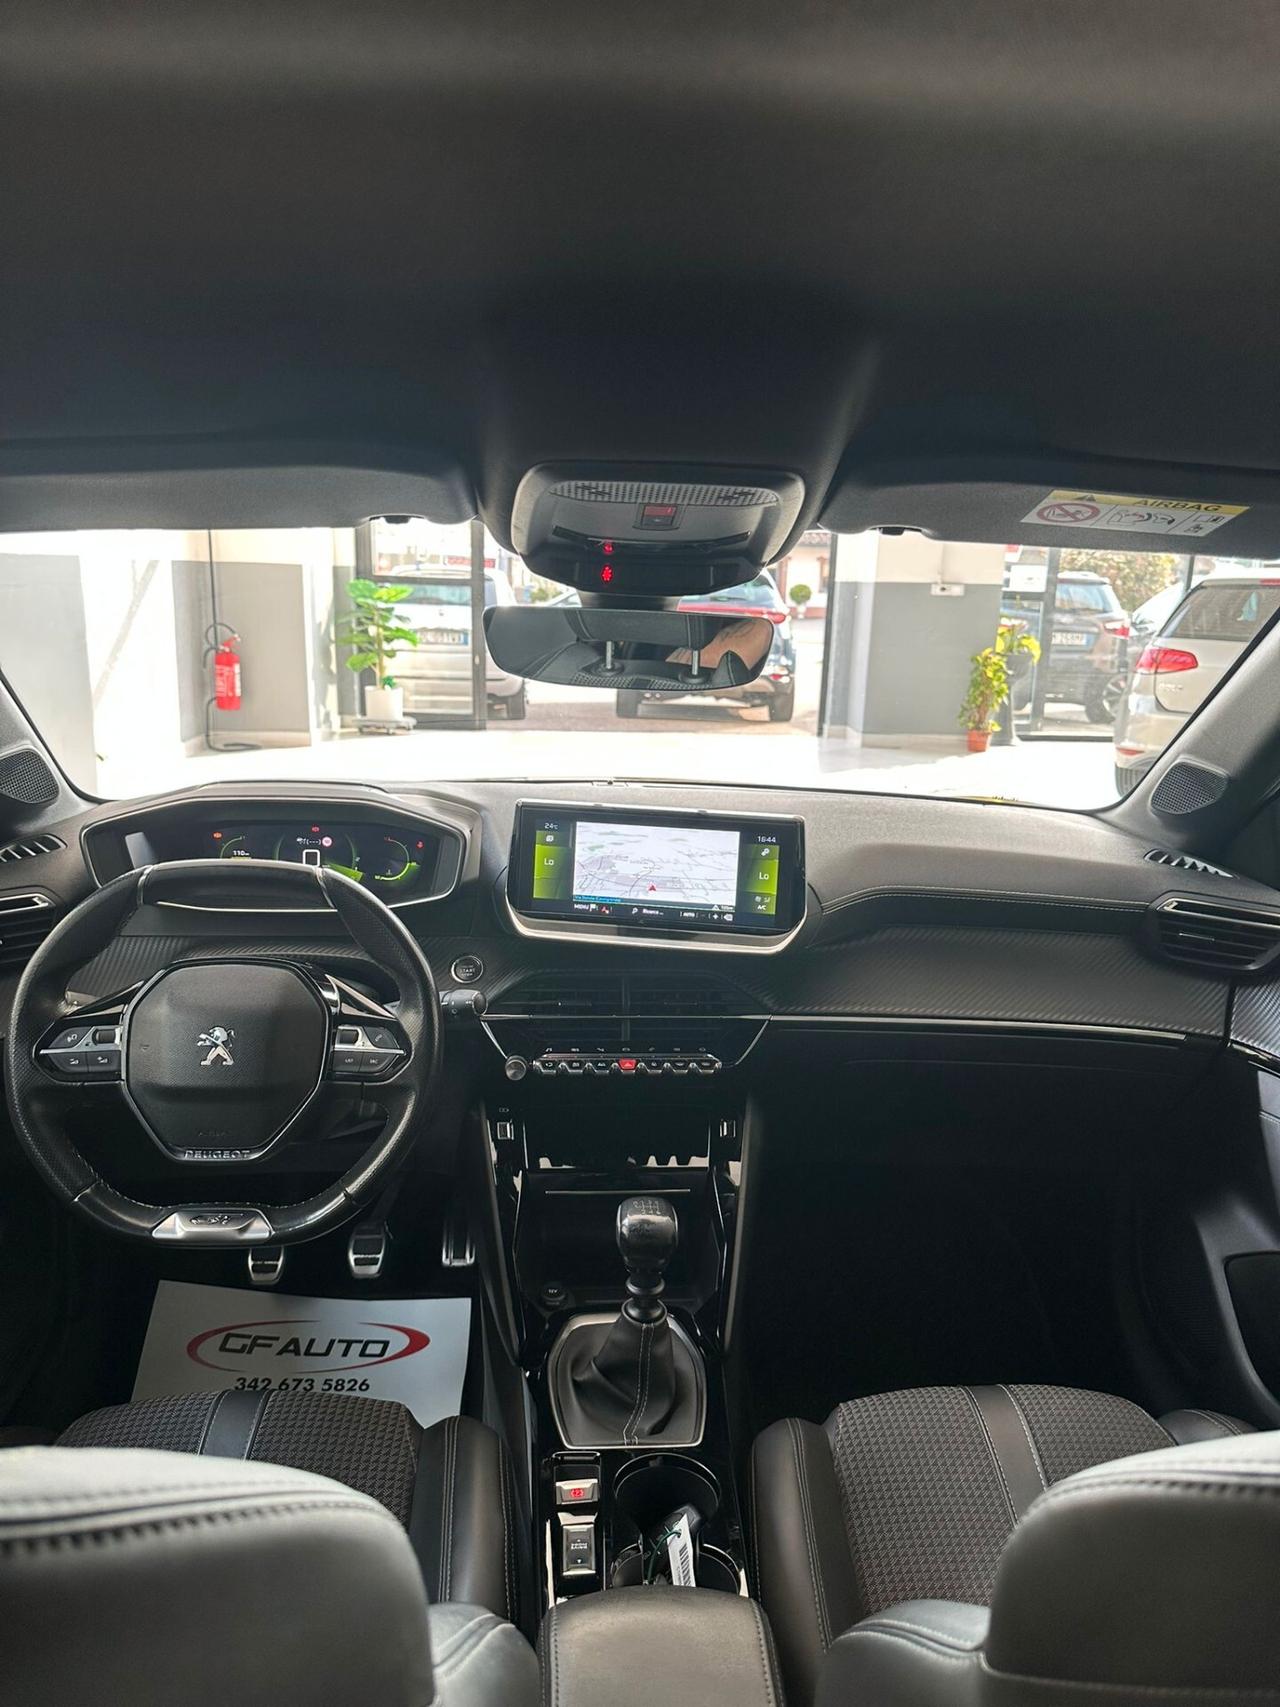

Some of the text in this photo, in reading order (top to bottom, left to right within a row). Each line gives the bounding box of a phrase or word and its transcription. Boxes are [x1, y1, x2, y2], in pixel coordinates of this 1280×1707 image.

[1133, 499, 1222, 512] AIRBAG
[543, 857, 555, 866] Lo
[758, 872, 770, 880] Lo
[184, 1150, 251, 1160] PEUGEOT
[234, 1377, 370, 1392] 342 673 5826
